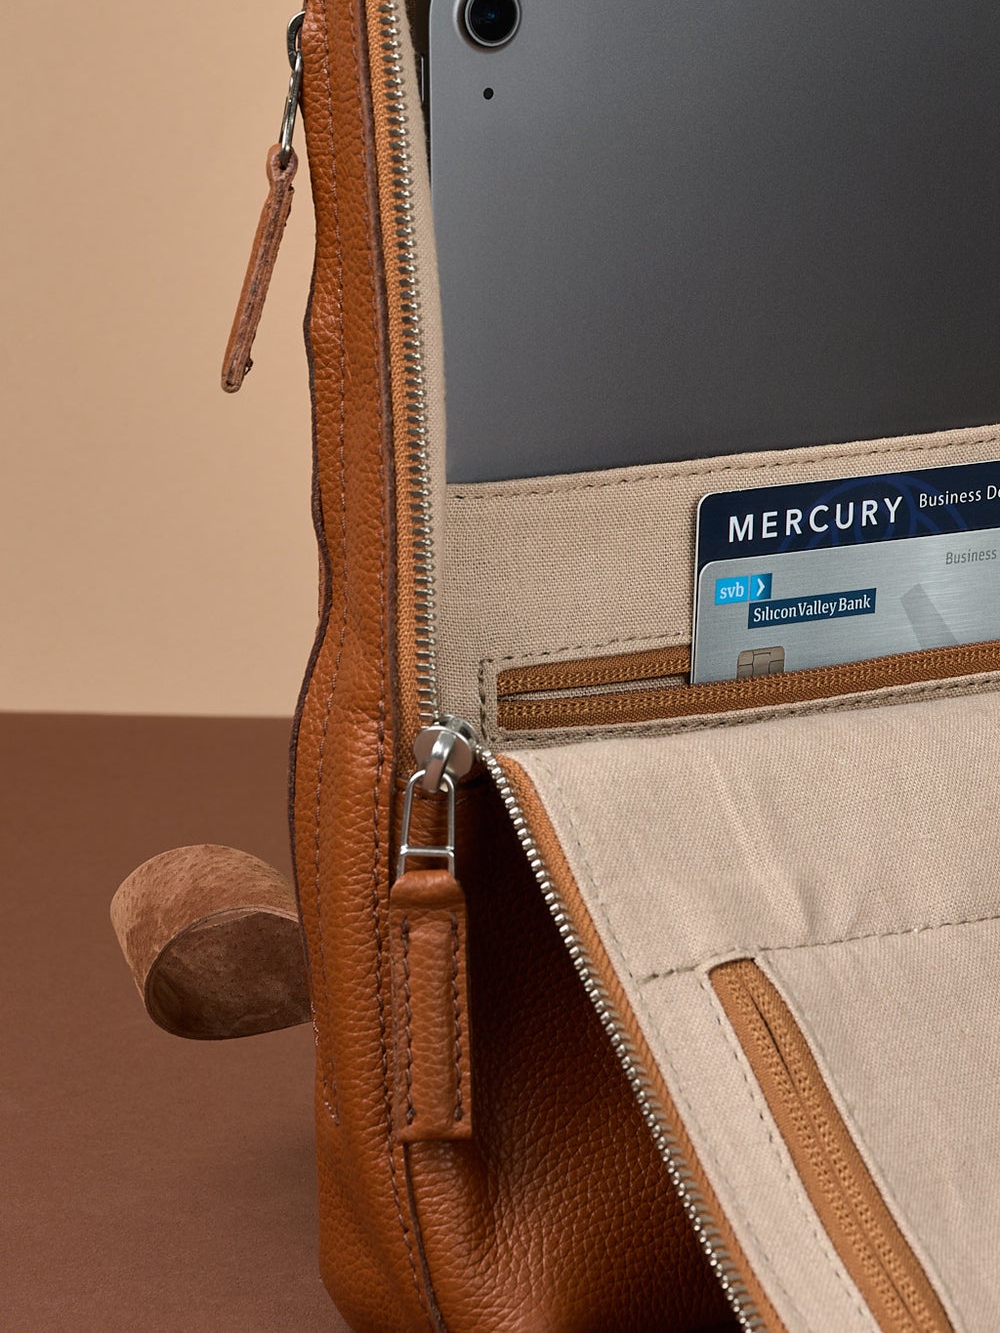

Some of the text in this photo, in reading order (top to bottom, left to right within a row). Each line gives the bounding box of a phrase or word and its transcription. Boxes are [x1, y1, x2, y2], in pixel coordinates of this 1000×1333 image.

[728, 496, 904, 543] MERCURY
[919, 489, 982, 509] Business
[945, 548, 998, 566] Business
[719, 581, 745, 600] svb
[797, 599, 837, 617] Valley
[838, 594, 872, 611] Bank
